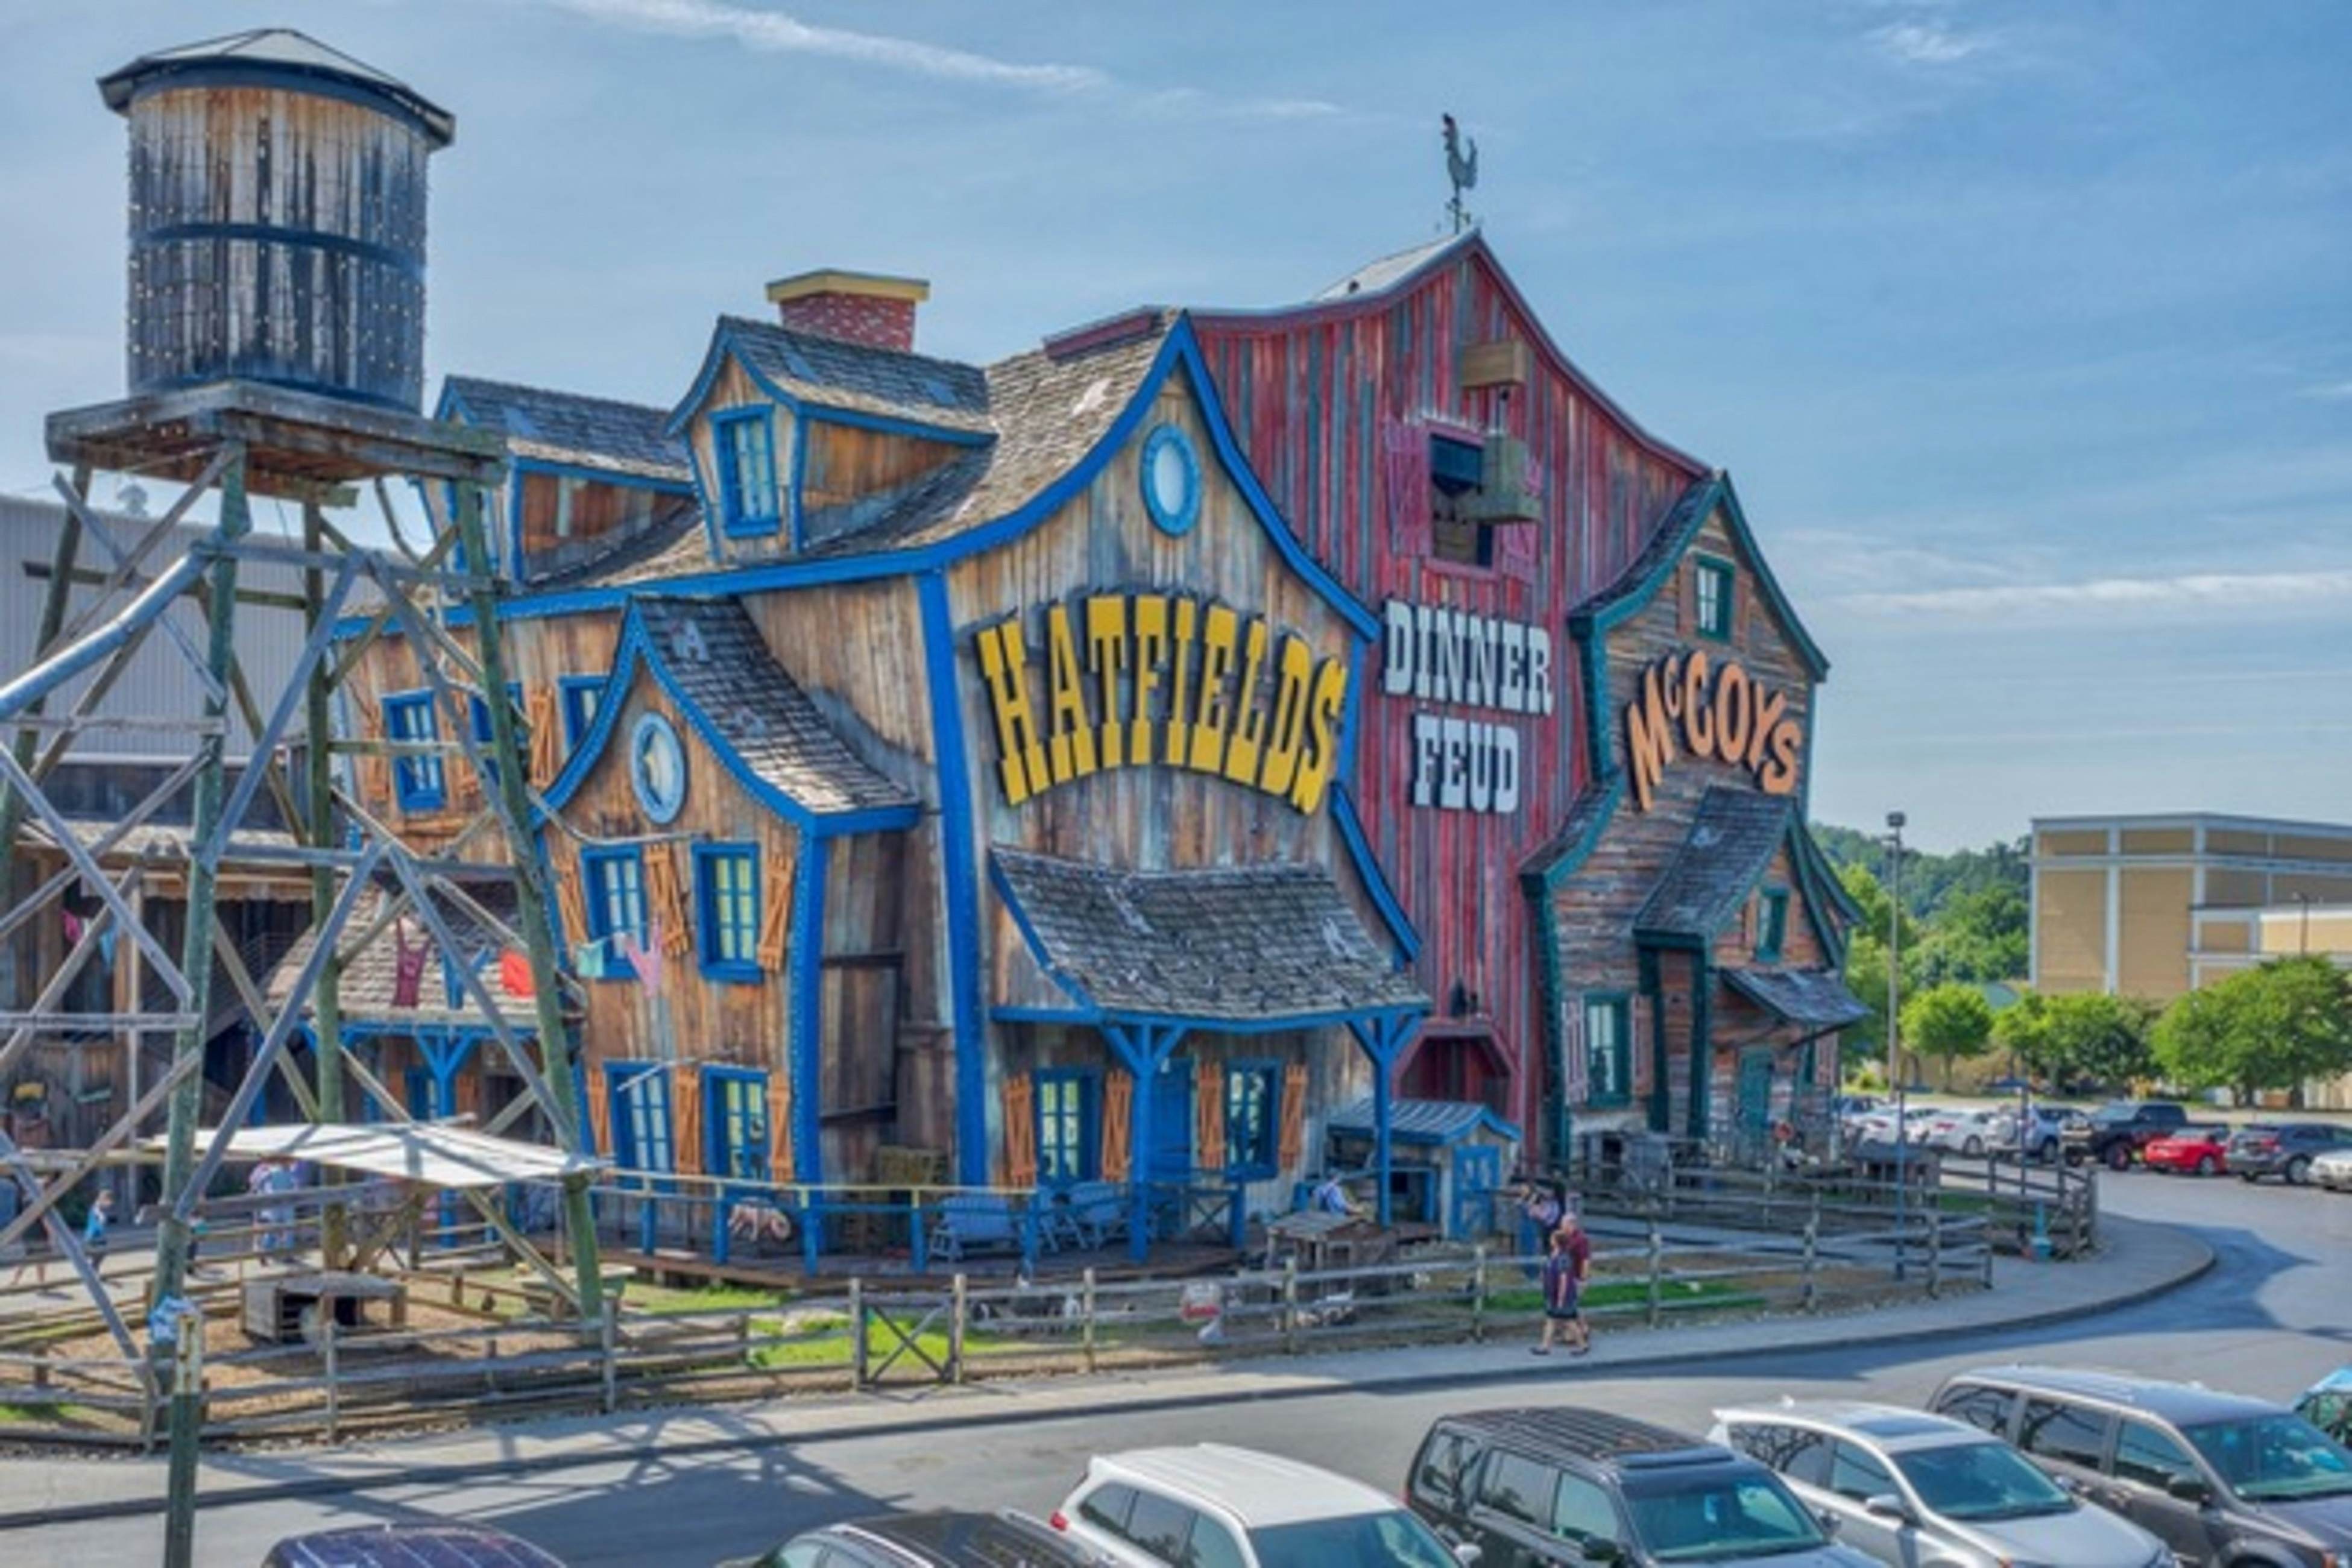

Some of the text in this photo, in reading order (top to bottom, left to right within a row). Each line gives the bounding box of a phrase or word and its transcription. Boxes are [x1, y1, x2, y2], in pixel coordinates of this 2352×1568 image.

[976, 594, 1348, 814] HATFIELDS
[1385, 599, 1554, 716] DINNER
[1413, 714, 1519, 813] FEUD
